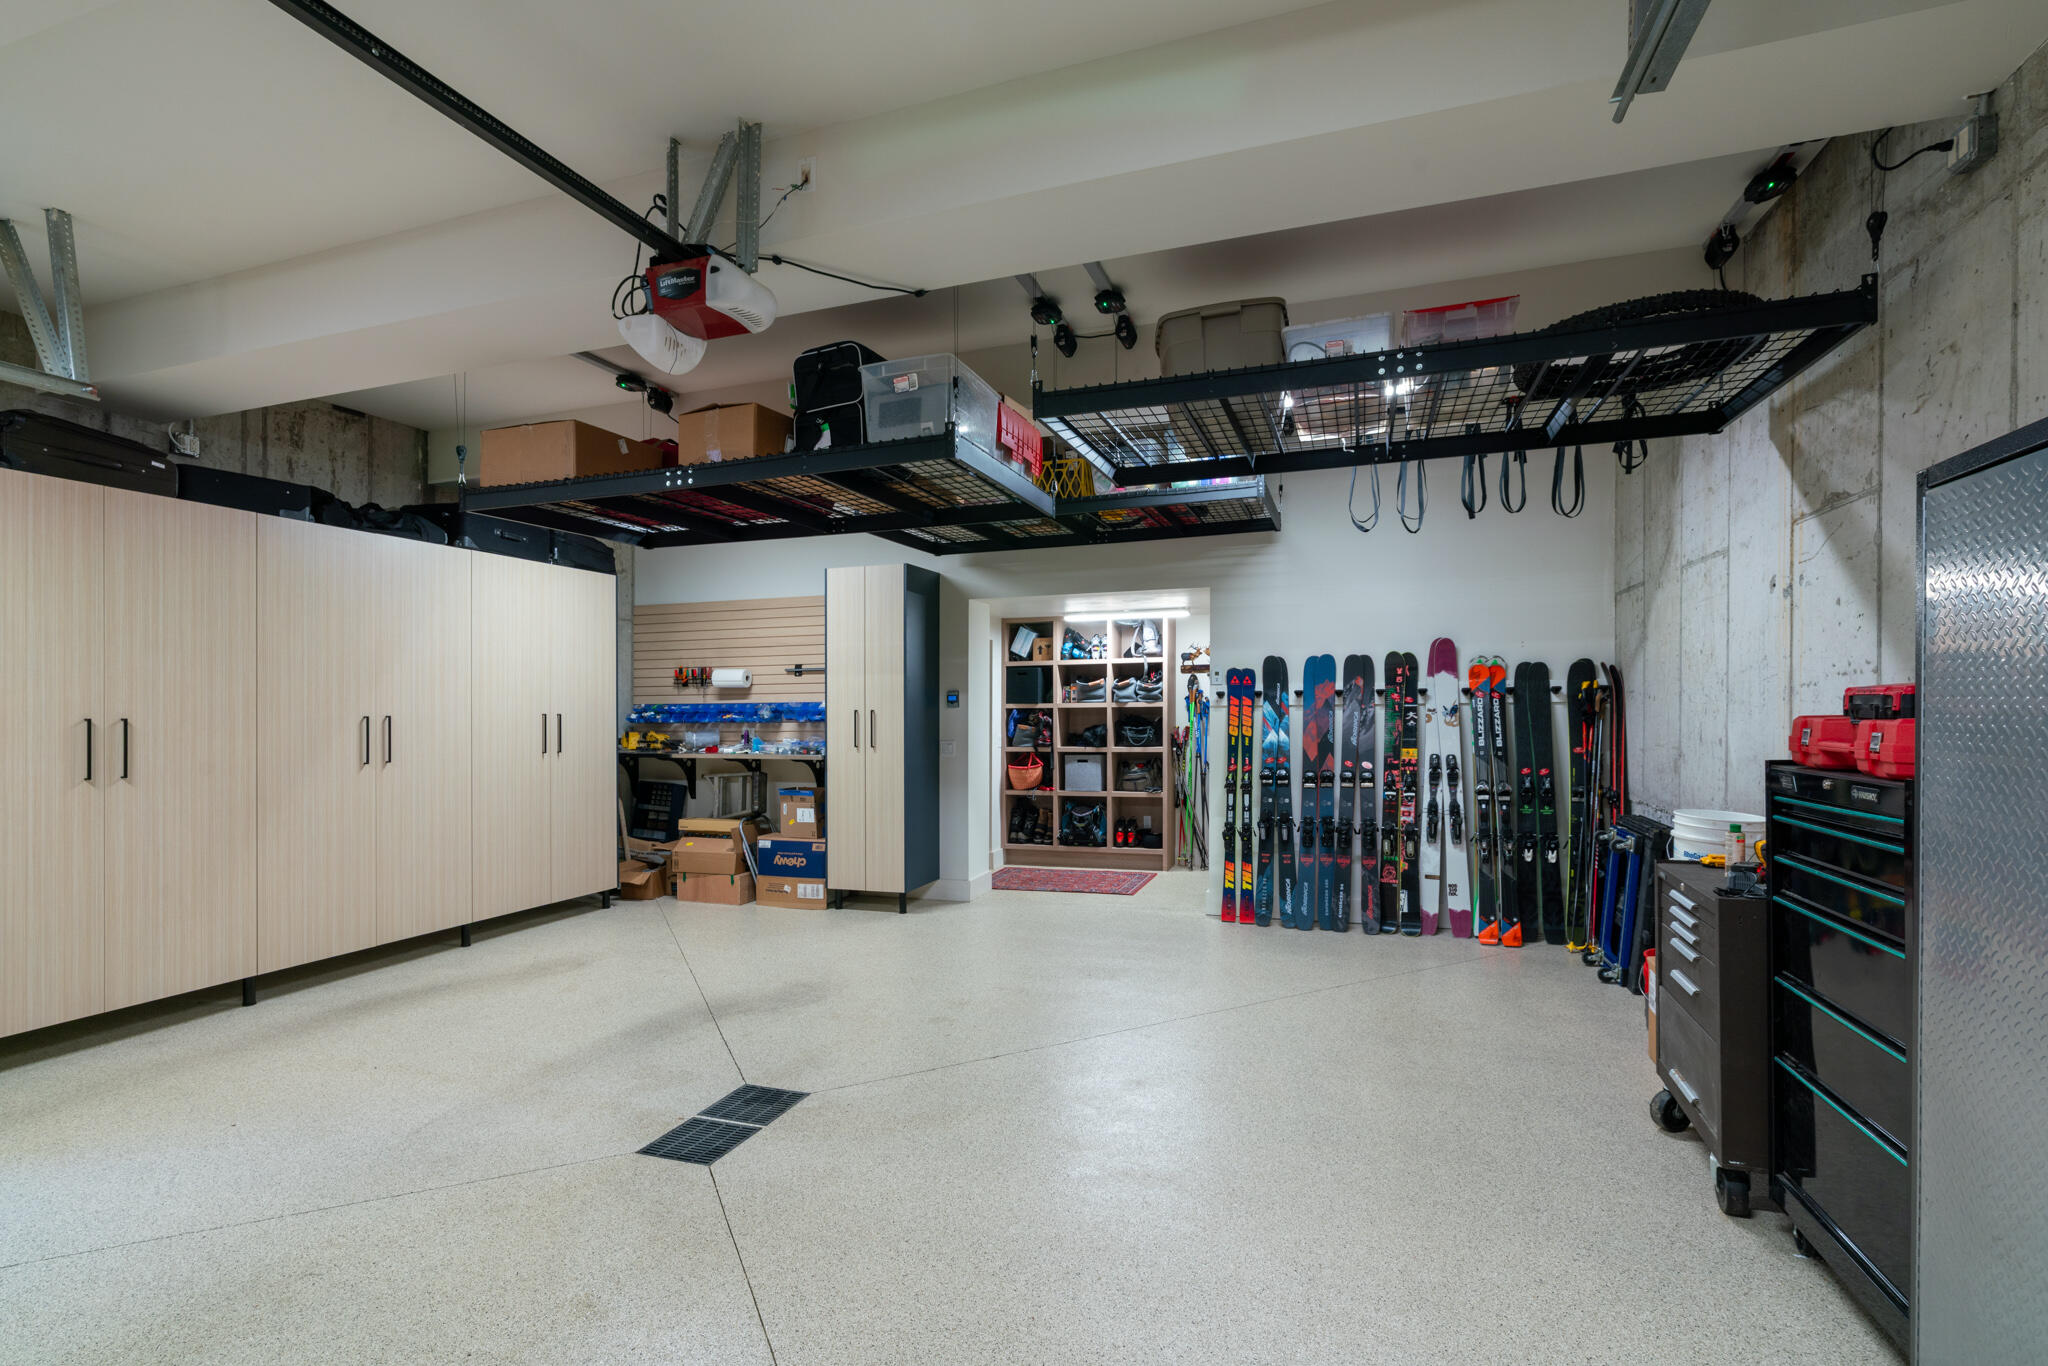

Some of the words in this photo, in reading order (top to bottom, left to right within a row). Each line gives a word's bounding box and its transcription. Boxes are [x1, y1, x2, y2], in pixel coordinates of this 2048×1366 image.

[659, 275, 696, 287] LiftMaster
[1229, 696, 1240, 736] CURV
[1242, 696, 1253, 737] CURV
[1477, 697, 1485, 746] BLIZZARD
[1493, 698, 1503, 747] BLIZZARD
[774, 855, 806, 868] chewy
[1224, 860, 1235, 889] THE
[1242, 862, 1253, 891] THE
[1284, 878, 1293, 915] NORDICA
